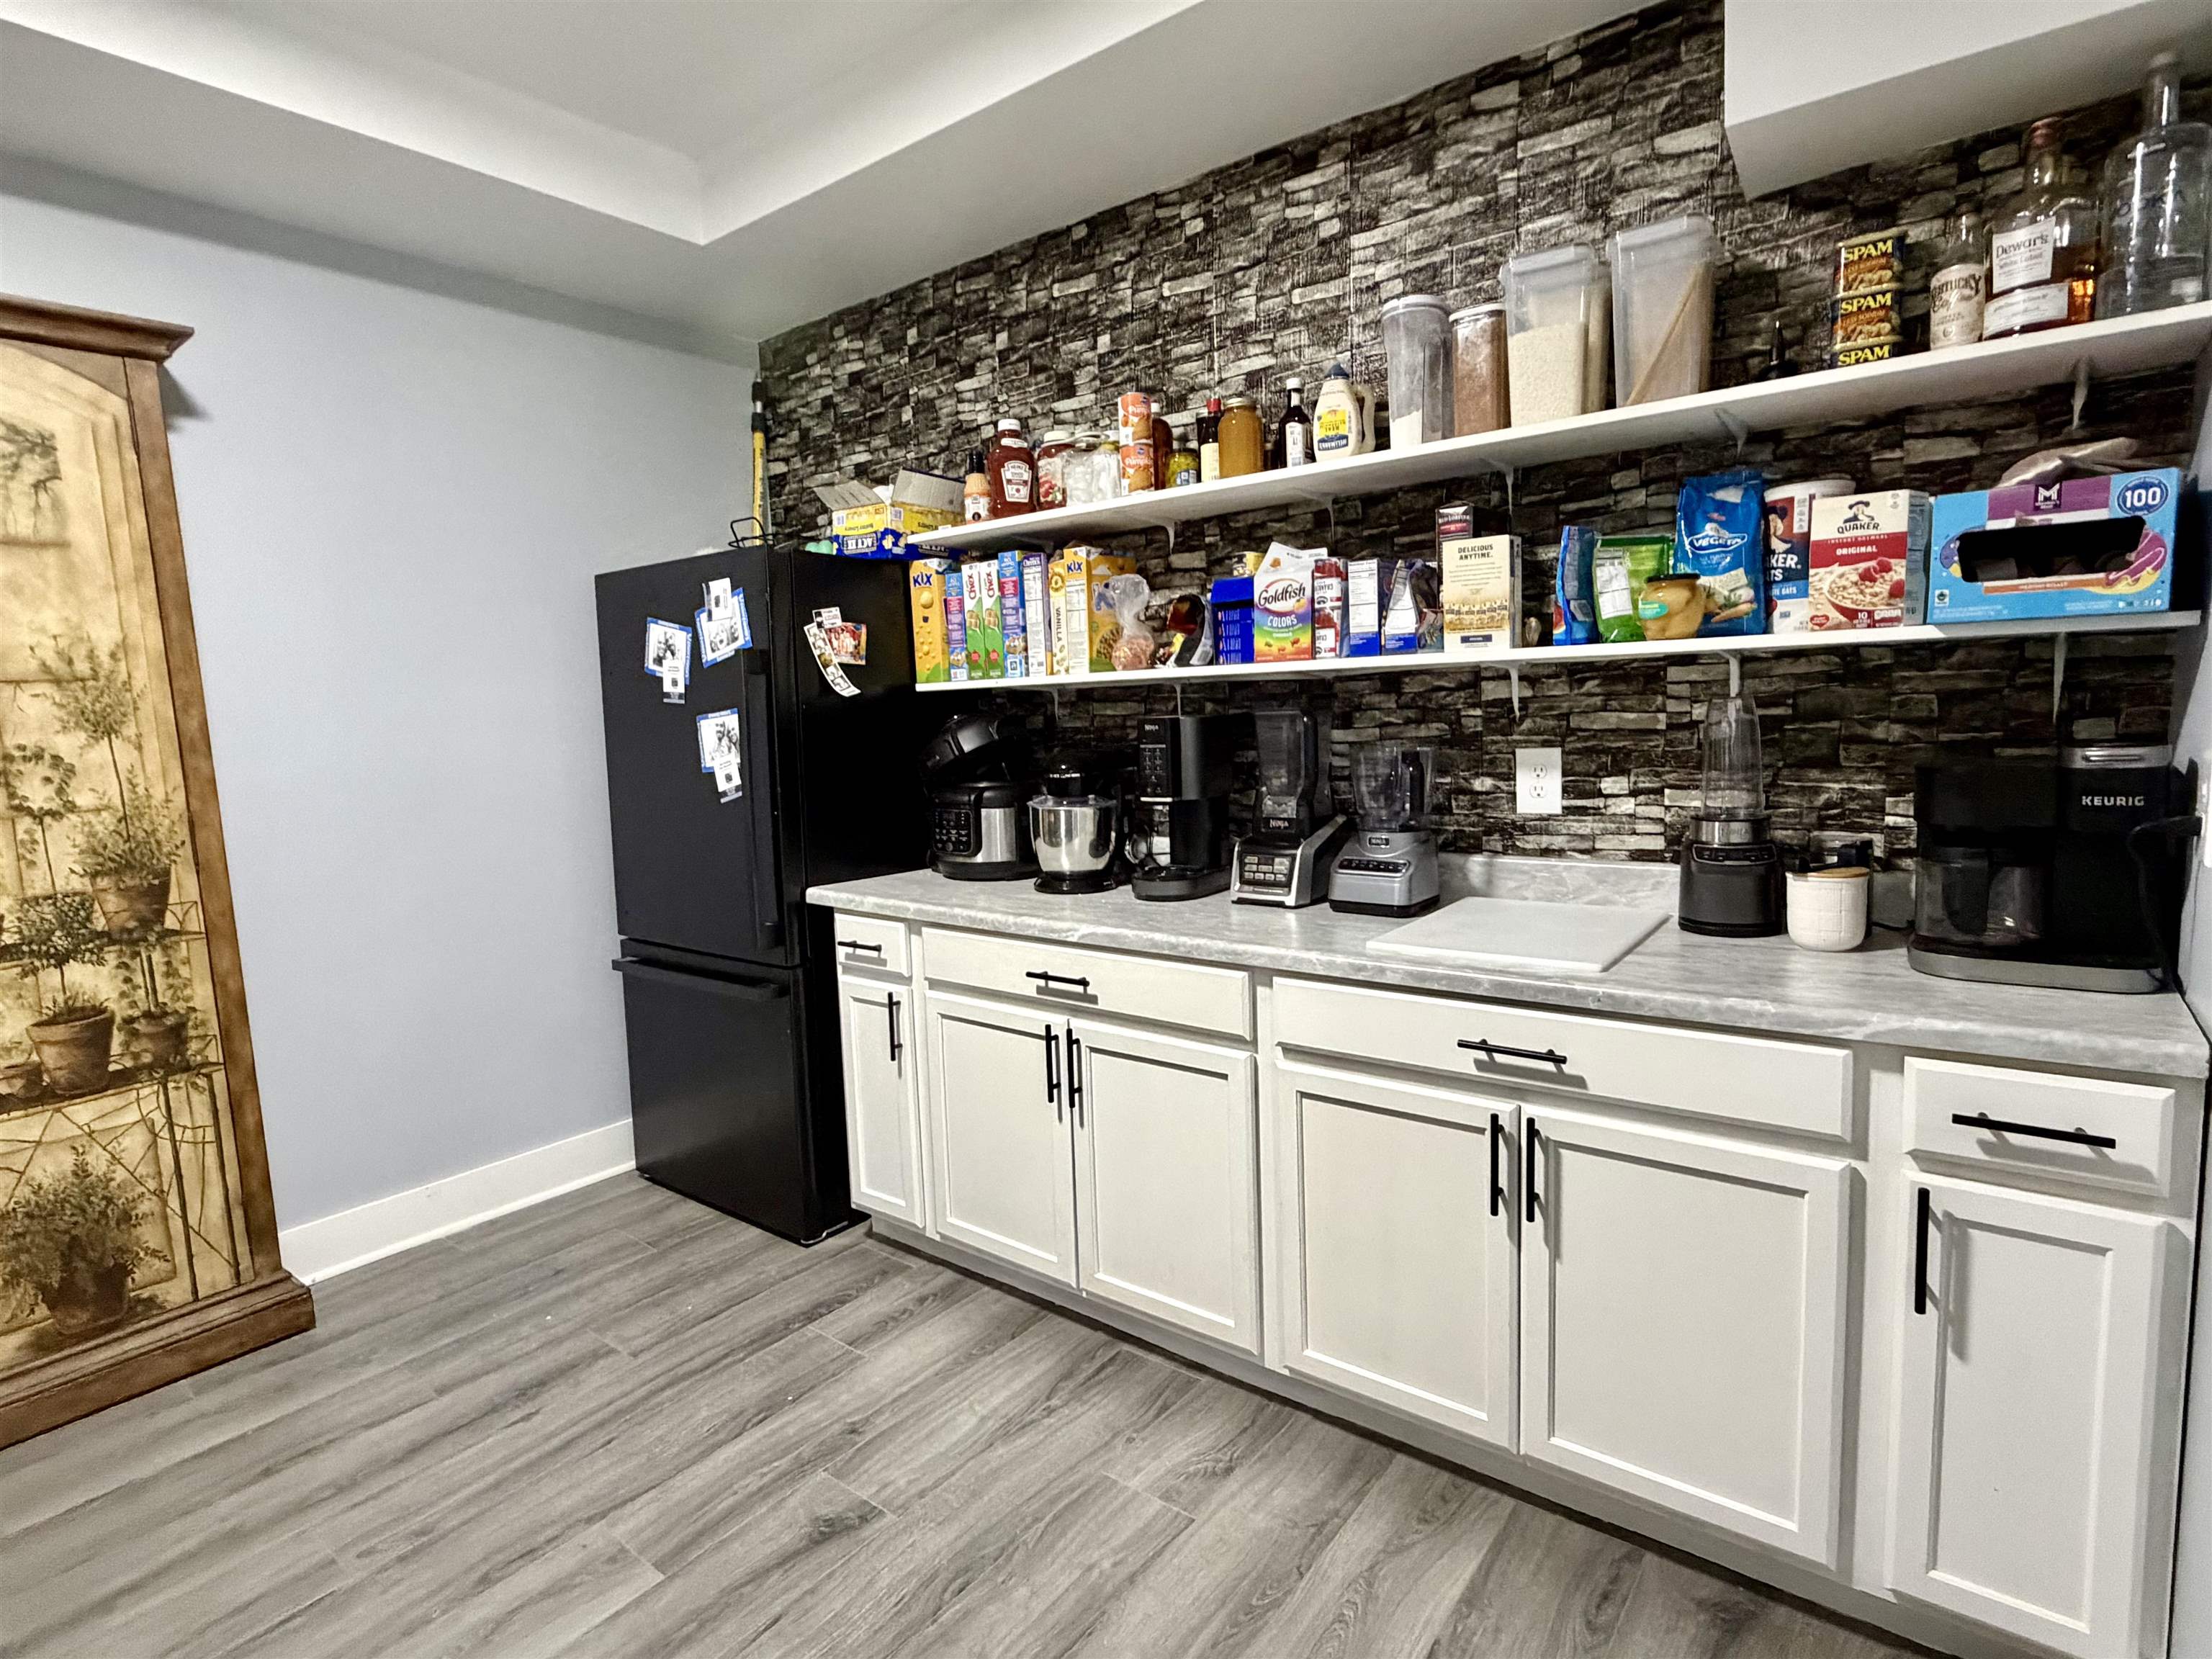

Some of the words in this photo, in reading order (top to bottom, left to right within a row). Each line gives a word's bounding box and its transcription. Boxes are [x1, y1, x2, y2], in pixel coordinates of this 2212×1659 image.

[1843, 239, 1894, 262] SPAM
[1995, 233, 2049, 258] Dewar's
[1840, 292, 1892, 314] SPAM
[1838, 344, 1891, 367] SPAM
[2125, 487, 2161, 508] 100
[1837, 522, 1880, 534] QUAKER
[1692, 536, 1742, 547] VEGETA
[1457, 544, 1493, 554] DELICIOUS
[1459, 552, 1493, 560] ANYTIME.
[1835, 545, 1878, 556] ORIGINAL
[1066, 560, 1083, 573] KIX
[1767, 554, 1802, 569] KER.
[912, 571, 933, 588] KIX
[986, 571, 995, 598] Chex
[967, 575, 976, 600] Chex
[1258, 582, 1306, 607] Goldfish
[1267, 614, 1298, 627] COLORS
[1857, 611, 1869, 620] 10
[2081, 795, 2145, 806] KEURIG
[1269, 819, 1290, 830] NINJA
